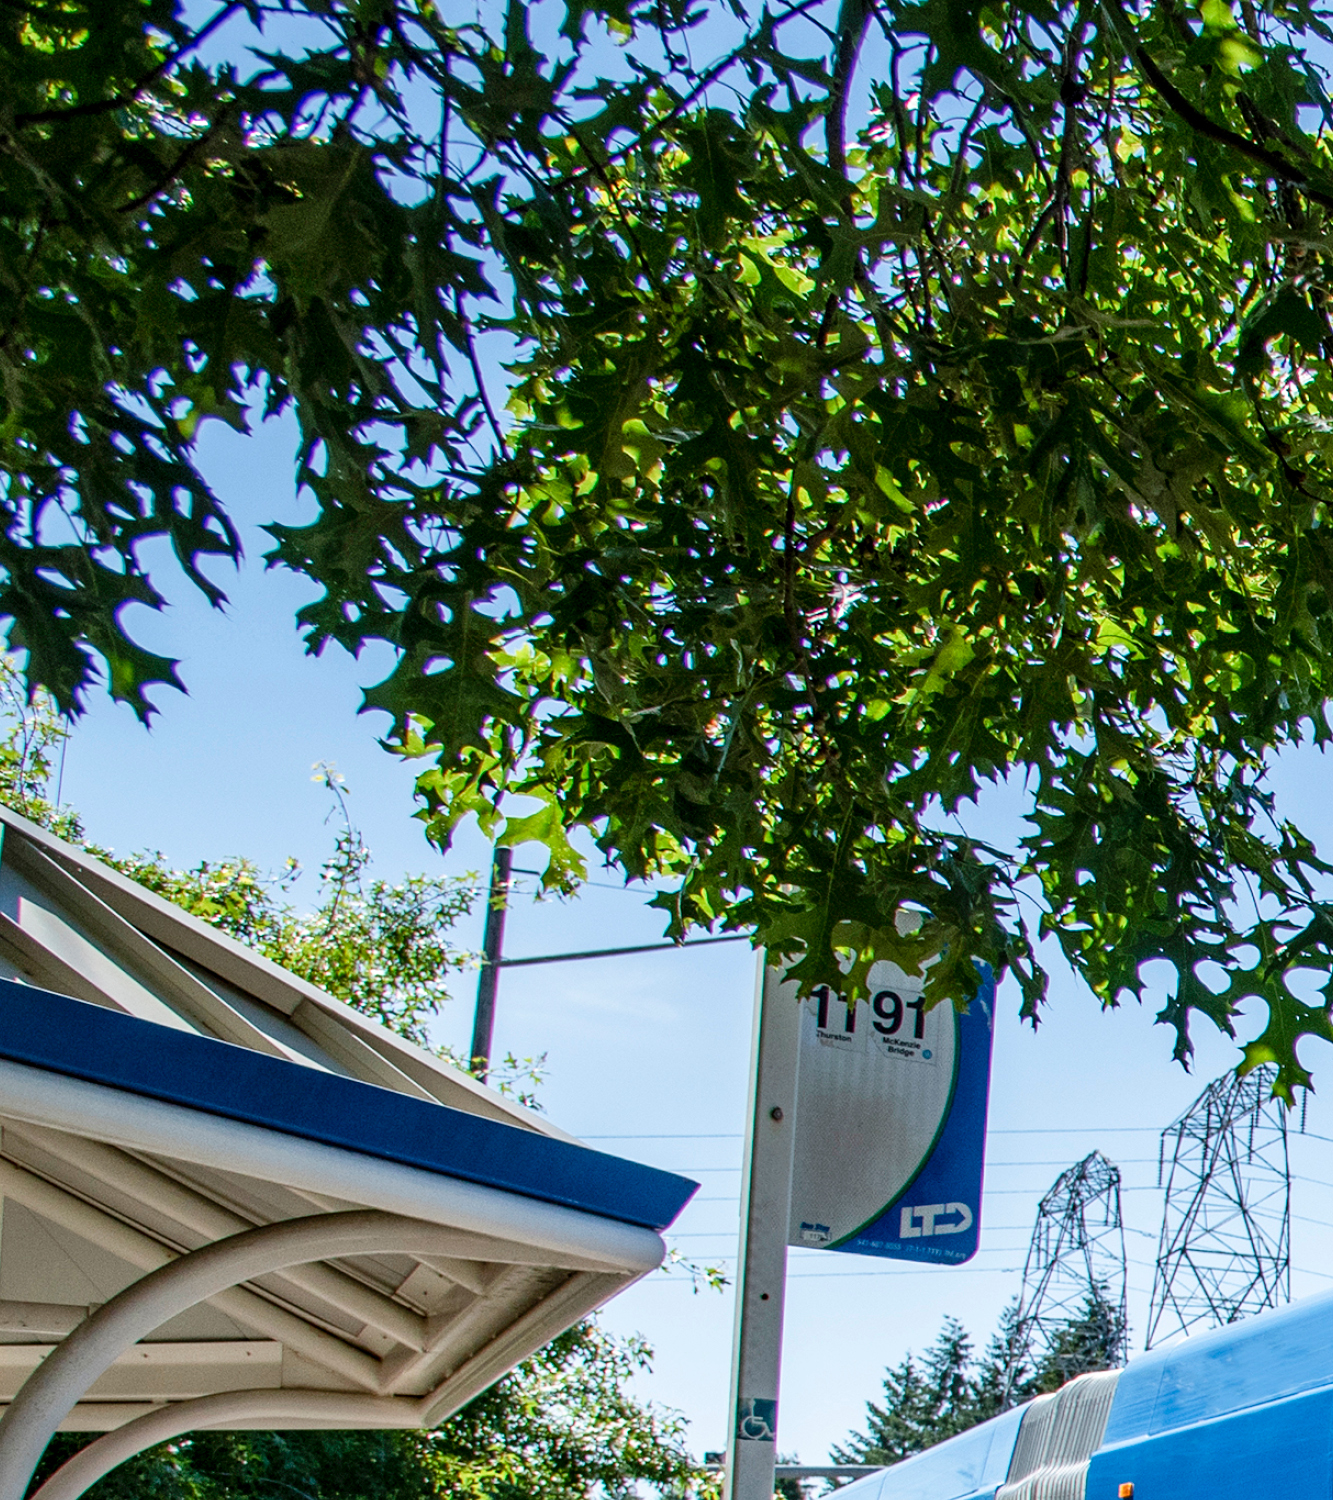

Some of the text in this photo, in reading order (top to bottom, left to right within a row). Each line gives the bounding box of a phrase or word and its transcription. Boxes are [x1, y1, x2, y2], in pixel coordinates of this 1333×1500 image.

[872, 990, 926, 1040] 91
[817, 1030, 852, 1043] Thurston
[882, 1036, 921, 1050] McKenzie
[887, 1045, 915, 1057] Bridge
[900, 1202, 973, 1239] LTD
